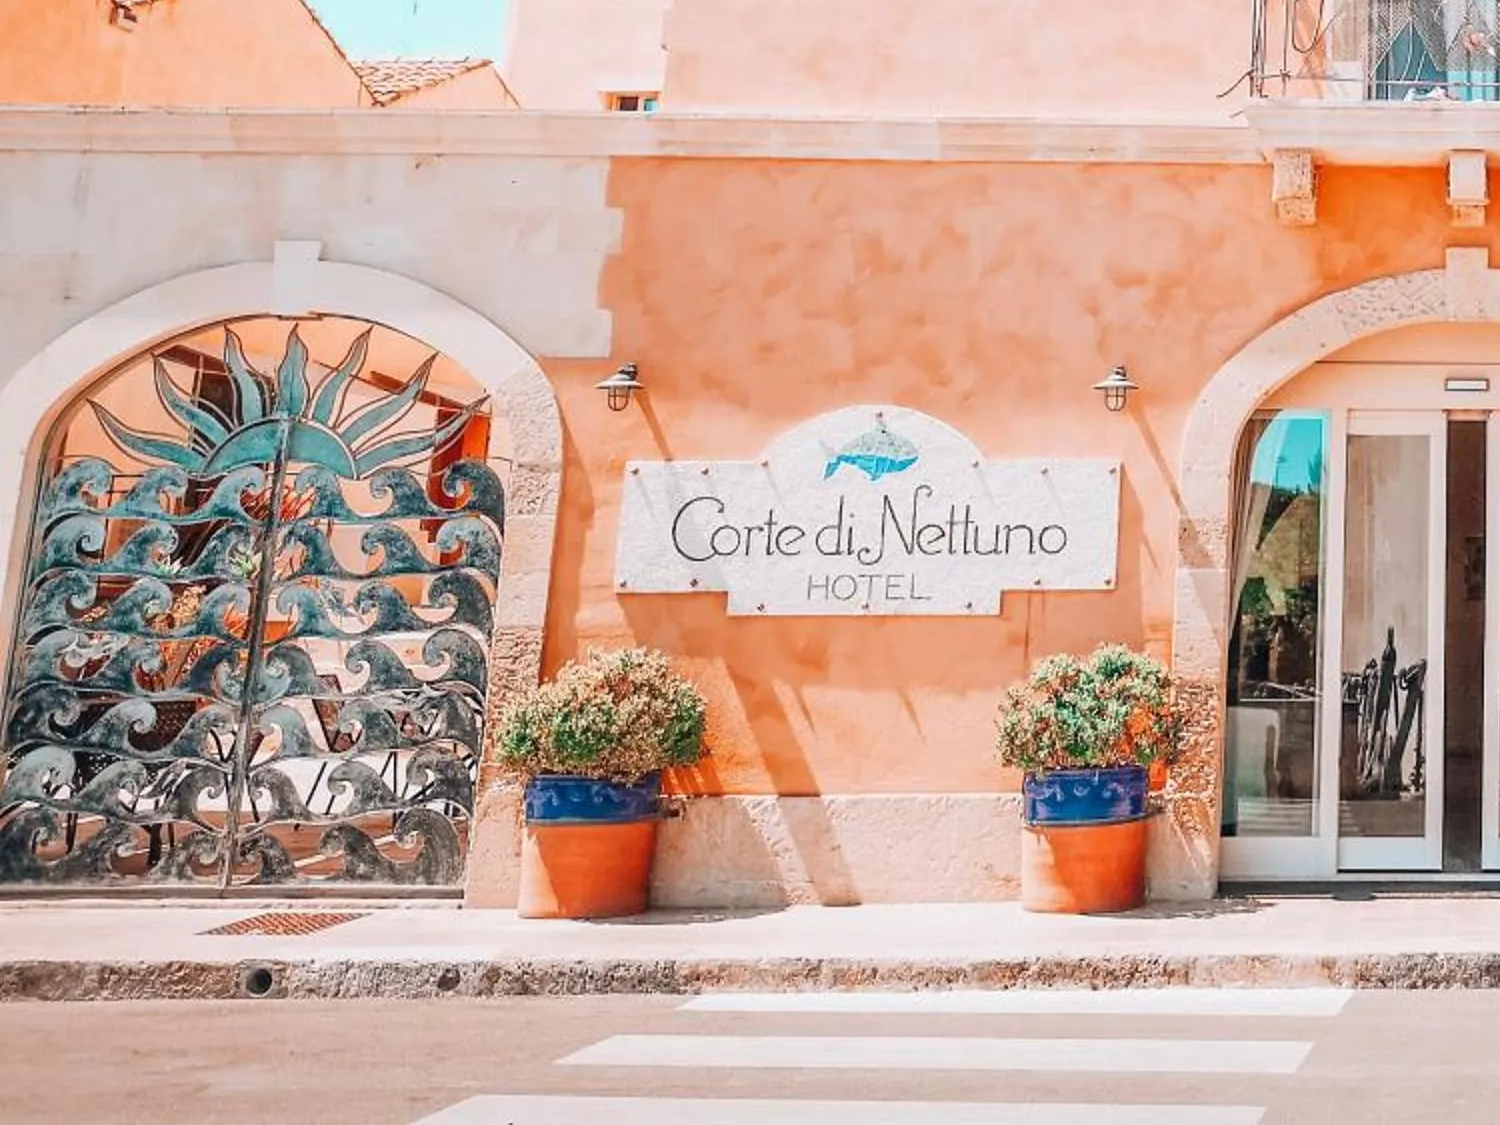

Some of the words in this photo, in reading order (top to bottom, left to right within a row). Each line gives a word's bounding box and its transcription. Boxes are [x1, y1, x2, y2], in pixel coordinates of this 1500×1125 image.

[671, 496, 805, 562] Corte
[815, 494, 855, 557] di
[857, 485, 1069, 566] Nettuno
[806, 573, 932, 602] HOTEL
